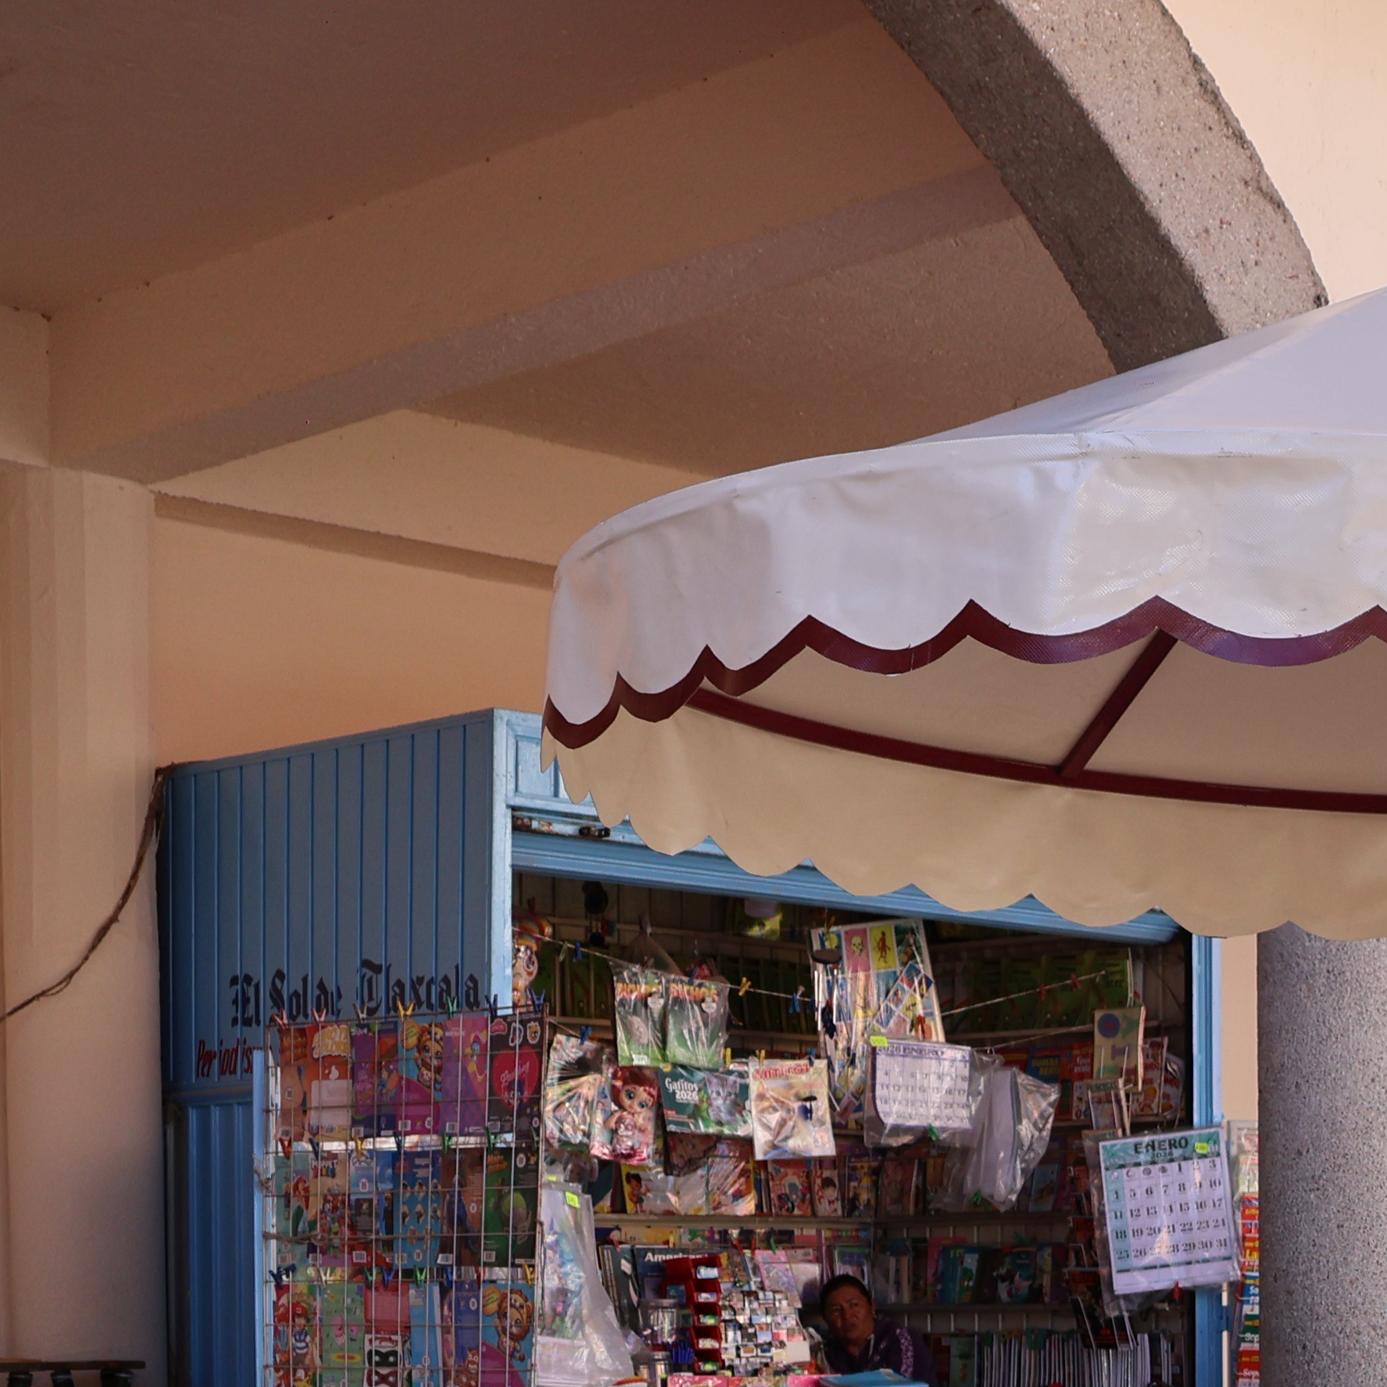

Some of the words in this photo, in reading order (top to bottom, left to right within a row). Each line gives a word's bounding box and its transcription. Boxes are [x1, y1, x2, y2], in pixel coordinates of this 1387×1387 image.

[229, 972, 262, 1028] El
[268, 968, 308, 1024] Sol
[356, 958, 479, 1020] Tlaxcala
[196, 1037, 262, 1078] Periodis
[665, 1077, 699, 1093] Gatitos
[675, 1089, 699, 1100] 2026
[1134, 1137, 1189, 1154] ENERO
[1209, 1179, 1221, 1188] 10
[1130, 1209, 1141, 1218] 12
[1212, 1199, 1222, 1208] 17
[1114, 1231, 1127, 1239] 18
[1180, 1223, 1193, 1232] 22
